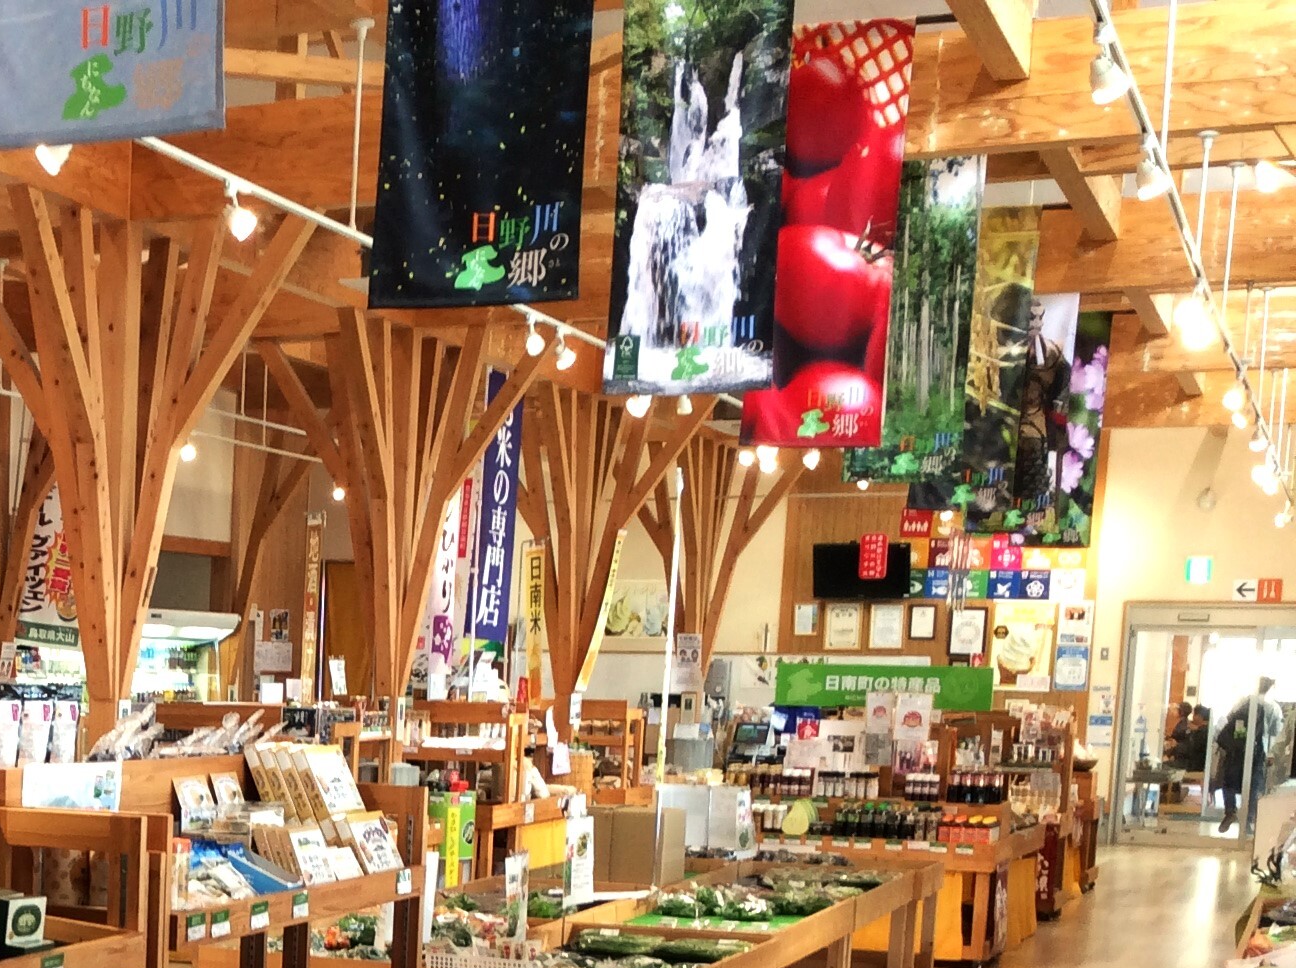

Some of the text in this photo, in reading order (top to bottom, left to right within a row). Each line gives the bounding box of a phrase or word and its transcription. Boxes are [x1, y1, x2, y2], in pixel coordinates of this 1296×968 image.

[442, 507, 455, 614] ひかり
[529, 556, 542, 635] 日南米
[825, 675, 942, 694] 日南町の特産品
